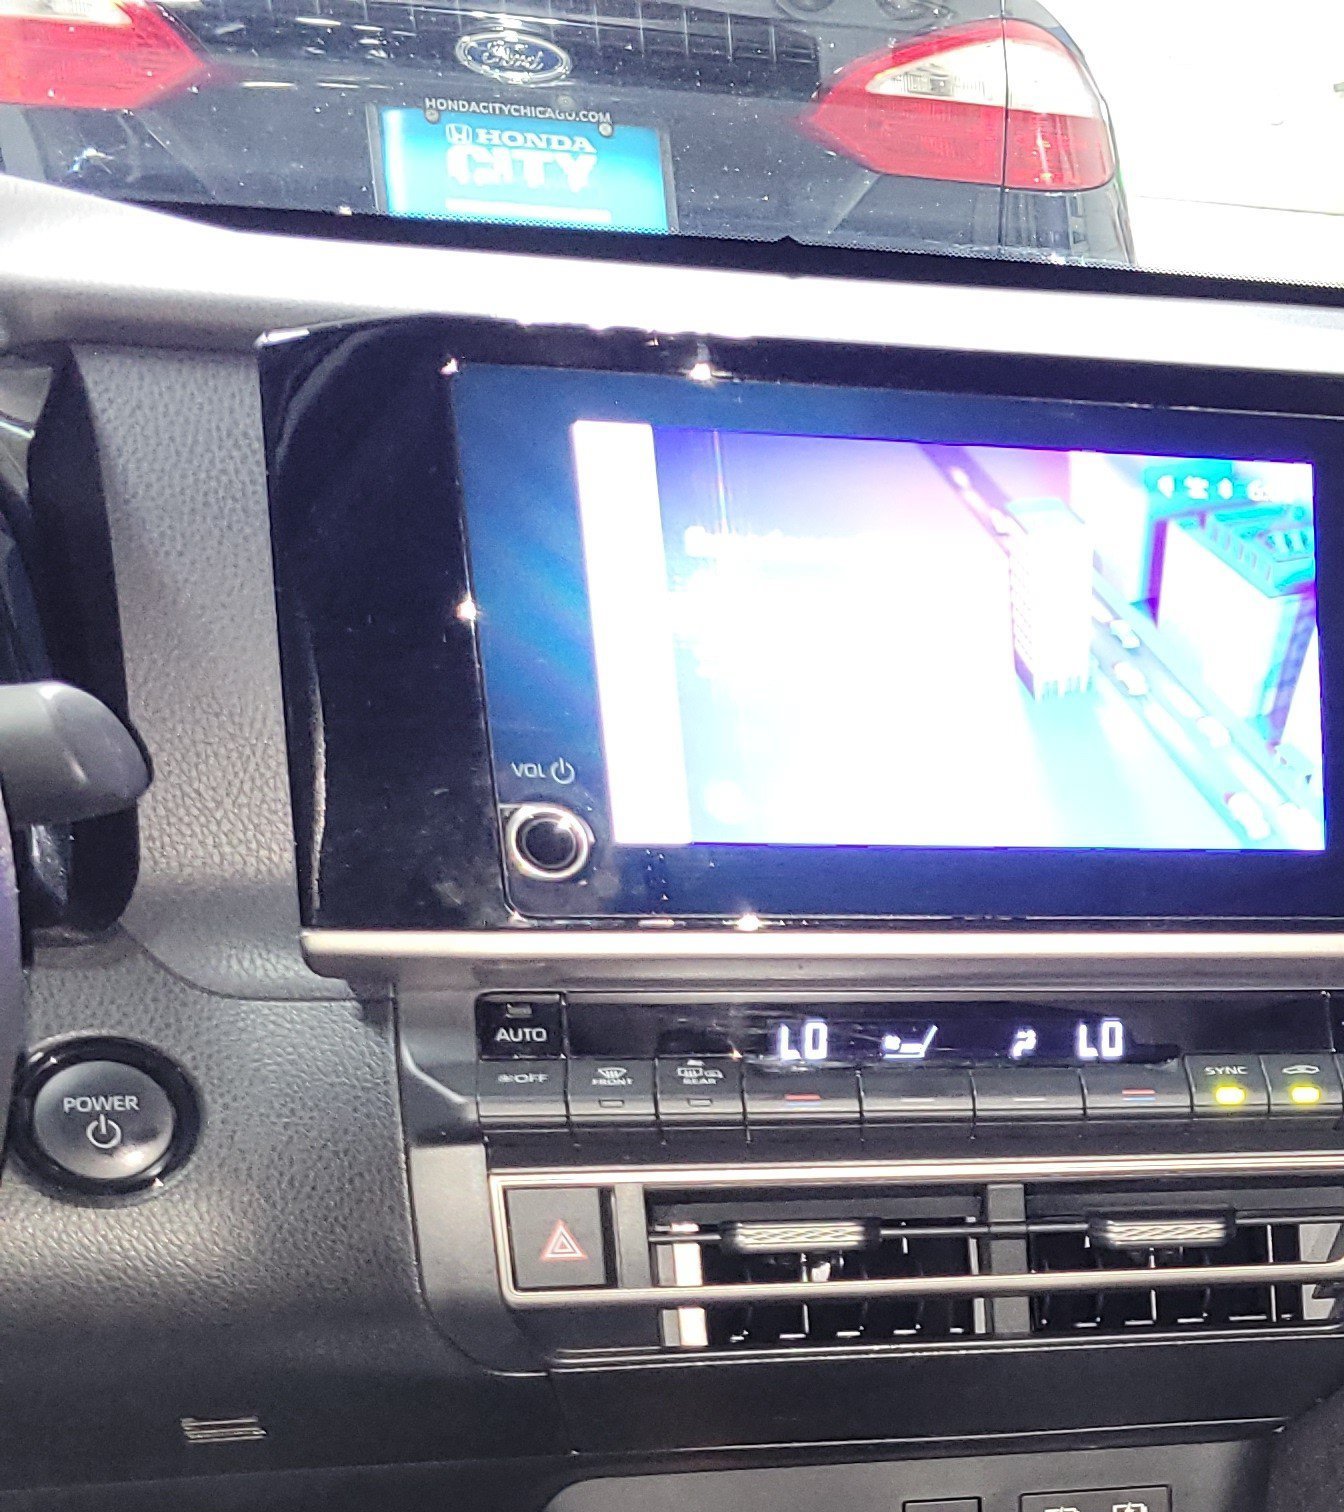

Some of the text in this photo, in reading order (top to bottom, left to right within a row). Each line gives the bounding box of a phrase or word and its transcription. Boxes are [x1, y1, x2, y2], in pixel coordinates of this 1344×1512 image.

[425, 97, 611, 124] HONDACITYCHICAGO.COM
[476, 128, 598, 153] HONDA
[446, 146, 597, 193] CITY
[511, 762, 546, 778] VOL
[495, 1027, 548, 1042] AUTO
[1205, 1065, 1249, 1076] SYNC
[514, 1073, 549, 1084] OFF
[592, 1077, 633, 1086] FRONT
[683, 1077, 717, 1085] REAR
[63, 1095, 140, 1113] POWER
